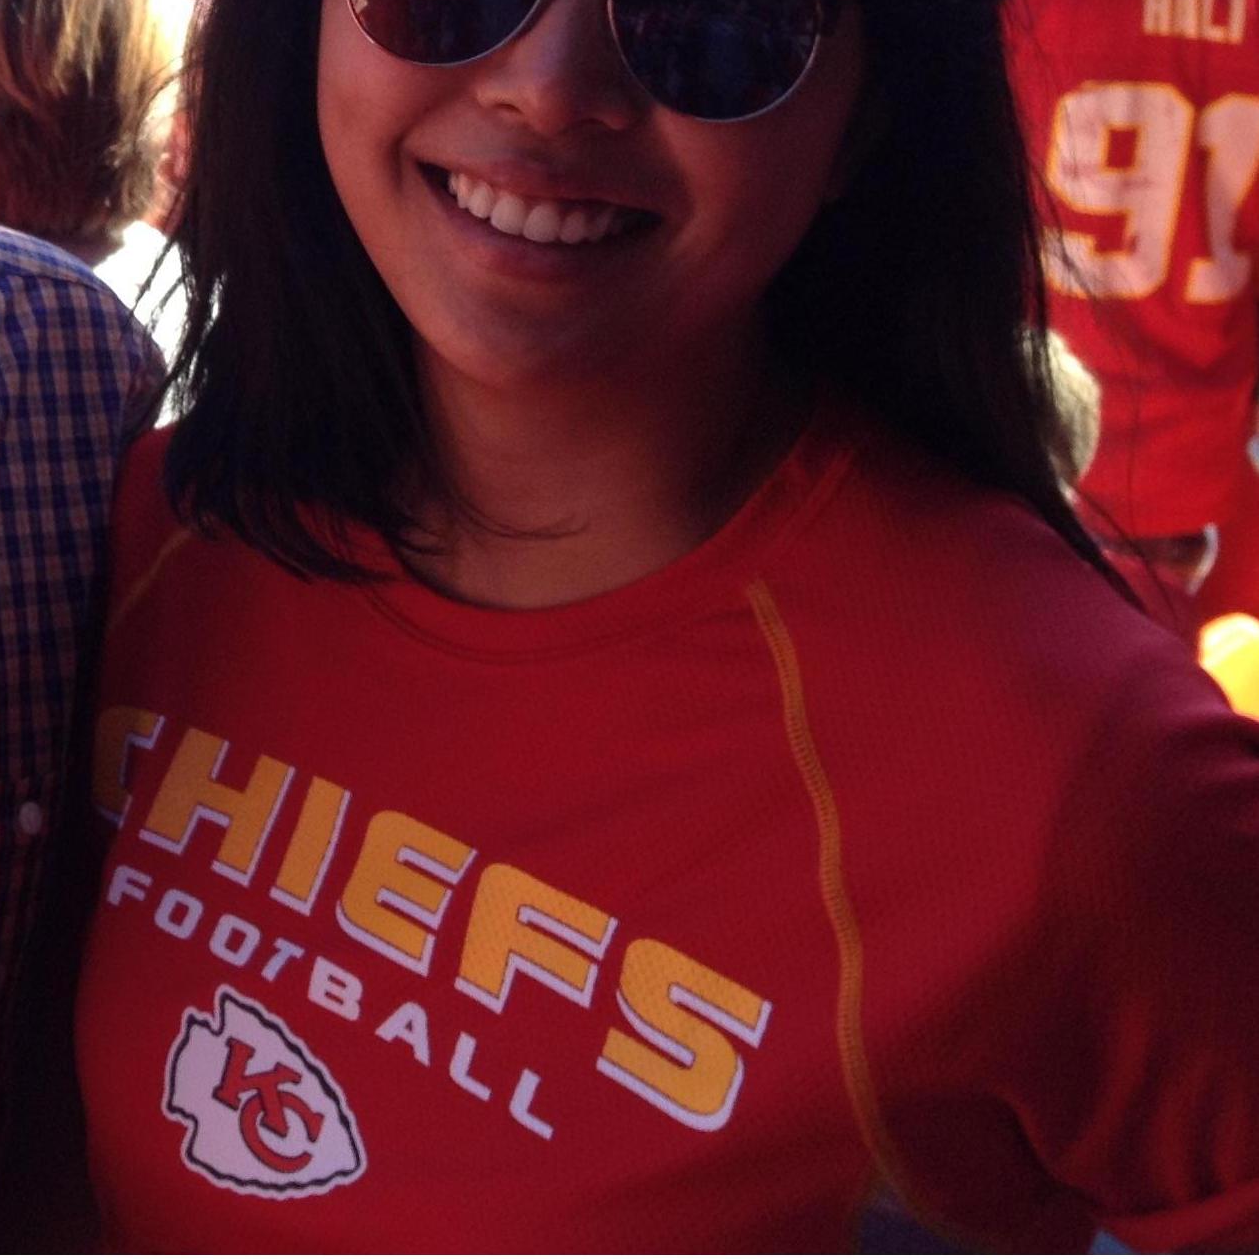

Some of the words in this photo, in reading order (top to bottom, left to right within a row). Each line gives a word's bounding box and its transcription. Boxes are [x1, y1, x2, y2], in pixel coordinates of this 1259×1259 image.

[1039, 78, 1259, 305] 91
[90, 704, 773, 1133] CHIEFS
[105, 863, 555, 1141] FOOTBALL
[211, 1038, 324, 1174] KC
